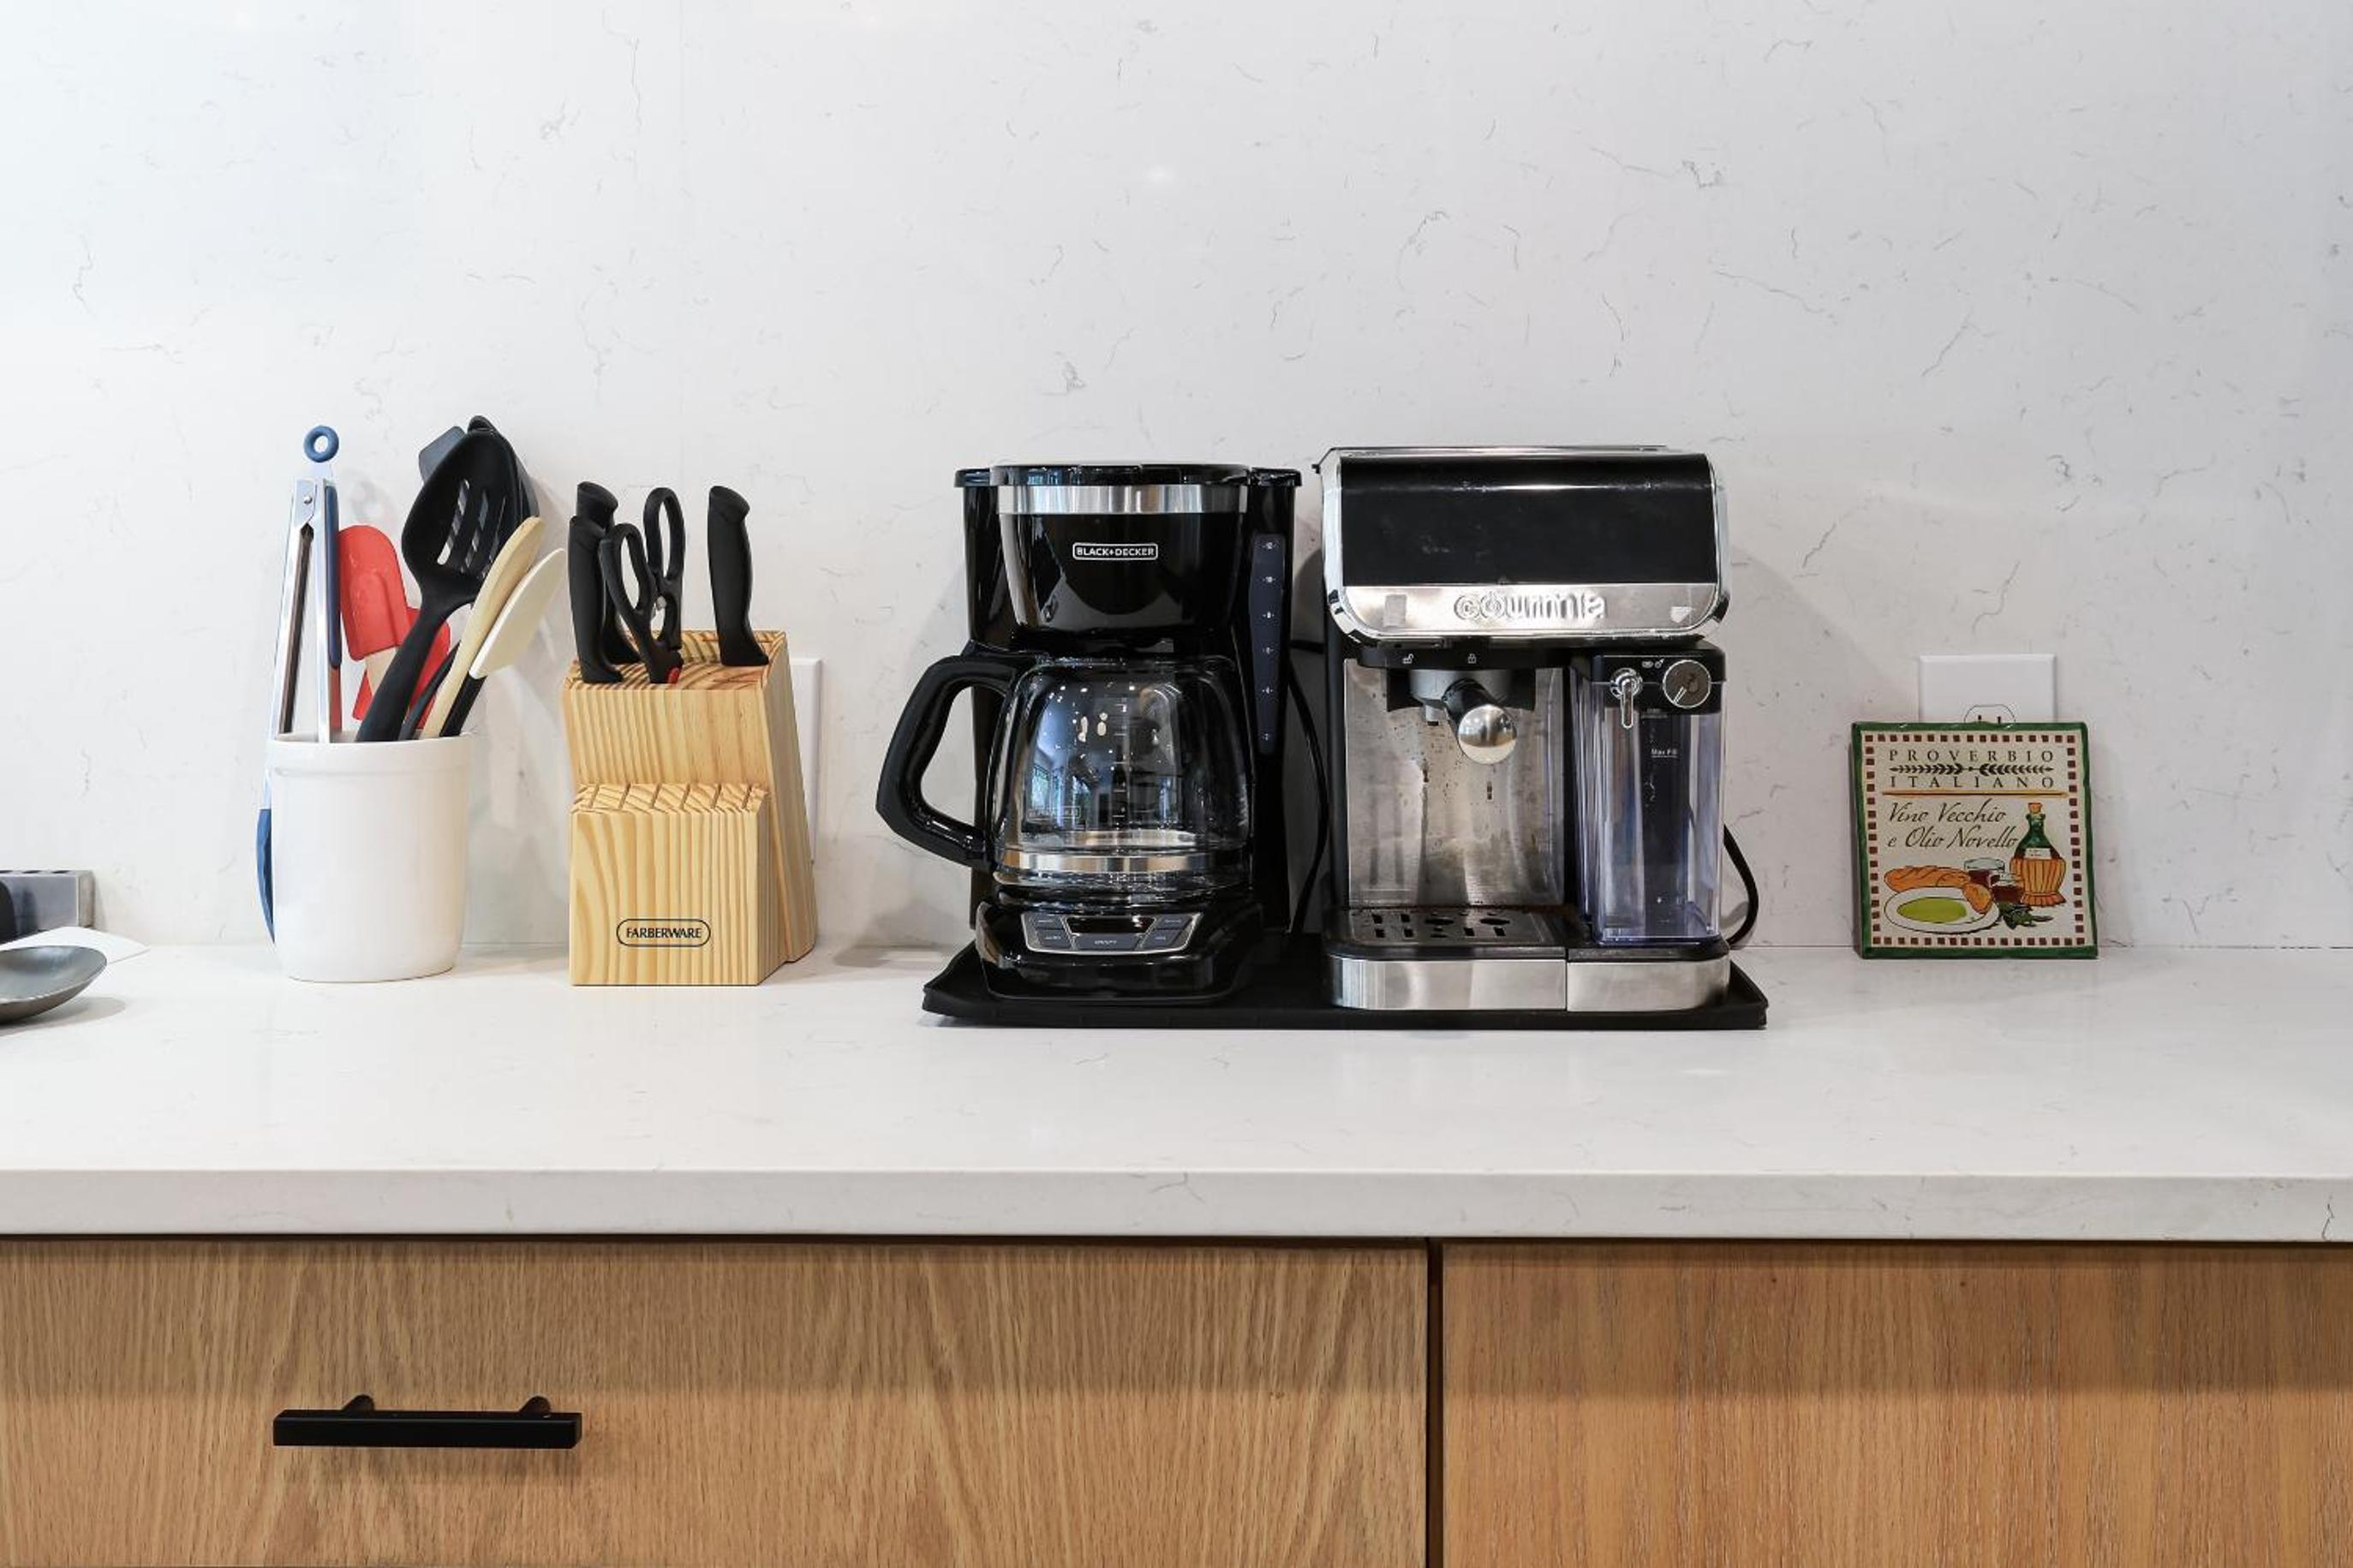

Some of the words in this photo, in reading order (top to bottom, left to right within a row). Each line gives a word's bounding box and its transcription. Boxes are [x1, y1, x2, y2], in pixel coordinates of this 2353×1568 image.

[1076, 547, 1155, 557] BLACK+DECKER
[1889, 749, 2054, 762] PROVERBIO
[1890, 776, 2055, 789] ITALIANO
[1889, 802, 1929, 823] Vino
[1938, 798, 2007, 823] Vecchio
[1887, 836, 1897, 848] e
[1904, 826, 1944, 848] Olio
[1946, 824, 2019, 849] Novello
[626, 927, 702, 939] FARBERWARE
